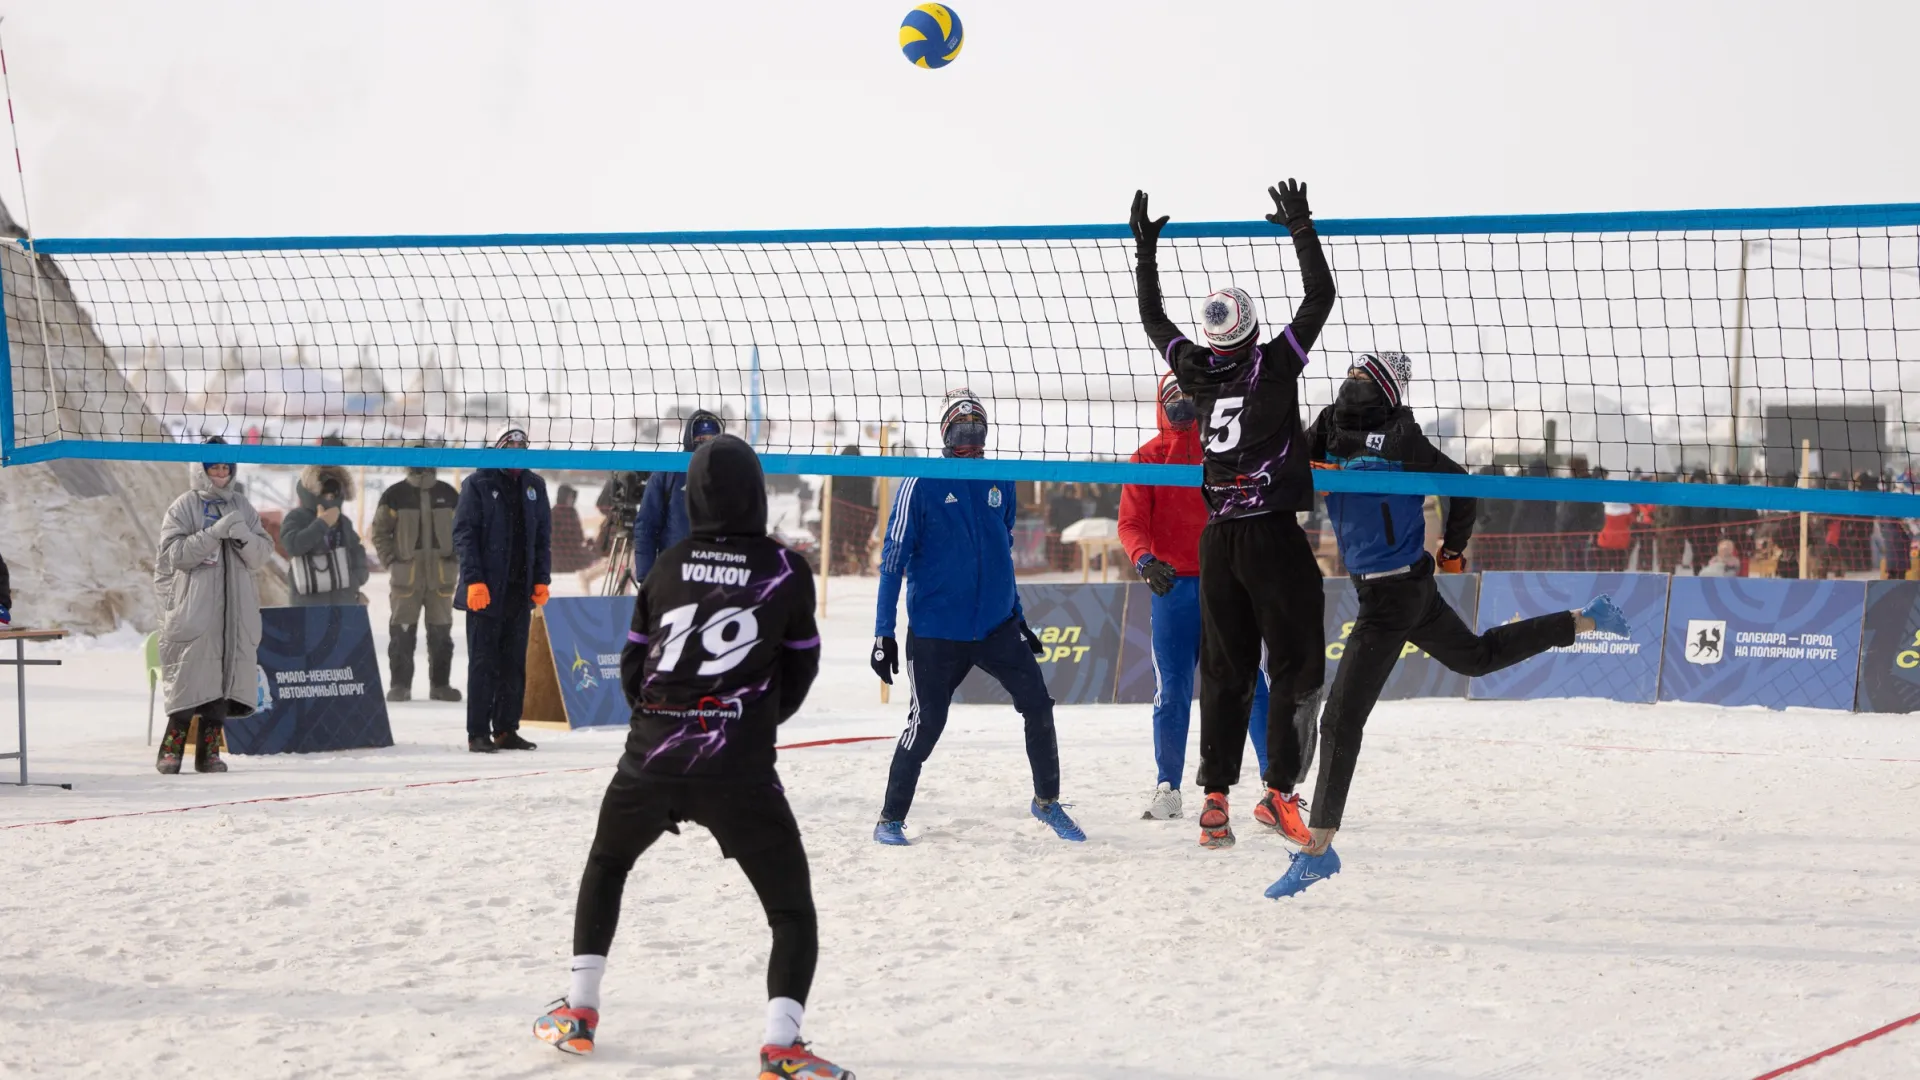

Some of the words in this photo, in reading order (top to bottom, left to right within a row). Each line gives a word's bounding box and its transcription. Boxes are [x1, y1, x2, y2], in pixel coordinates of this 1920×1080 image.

[1206, 396, 1245, 453] 5
[691, 550, 747, 563] КАРЕЛИЯ
[682, 563, 751, 586] VOLKOV
[656, 602, 764, 676] 19
[1736, 631, 1786, 646] САЛЕХАРД
[1801, 633, 1833, 647] ГОРОД
[1036, 646, 1090, 663] ОРТ
[1609, 643, 1641, 655] ОКРУГ
[1734, 646, 1748, 657] НА
[1750, 646, 1805, 659] ПОЛЯРНОМ
[1806, 648, 1838, 660] КРУГЕ
[276, 667, 353, 683] ЯМАЛО-НЕНЕЦКИЙ
[279, 682, 338, 699] АВТОНОМНЫЙ
[339, 683, 364, 696] ОКРУГ
